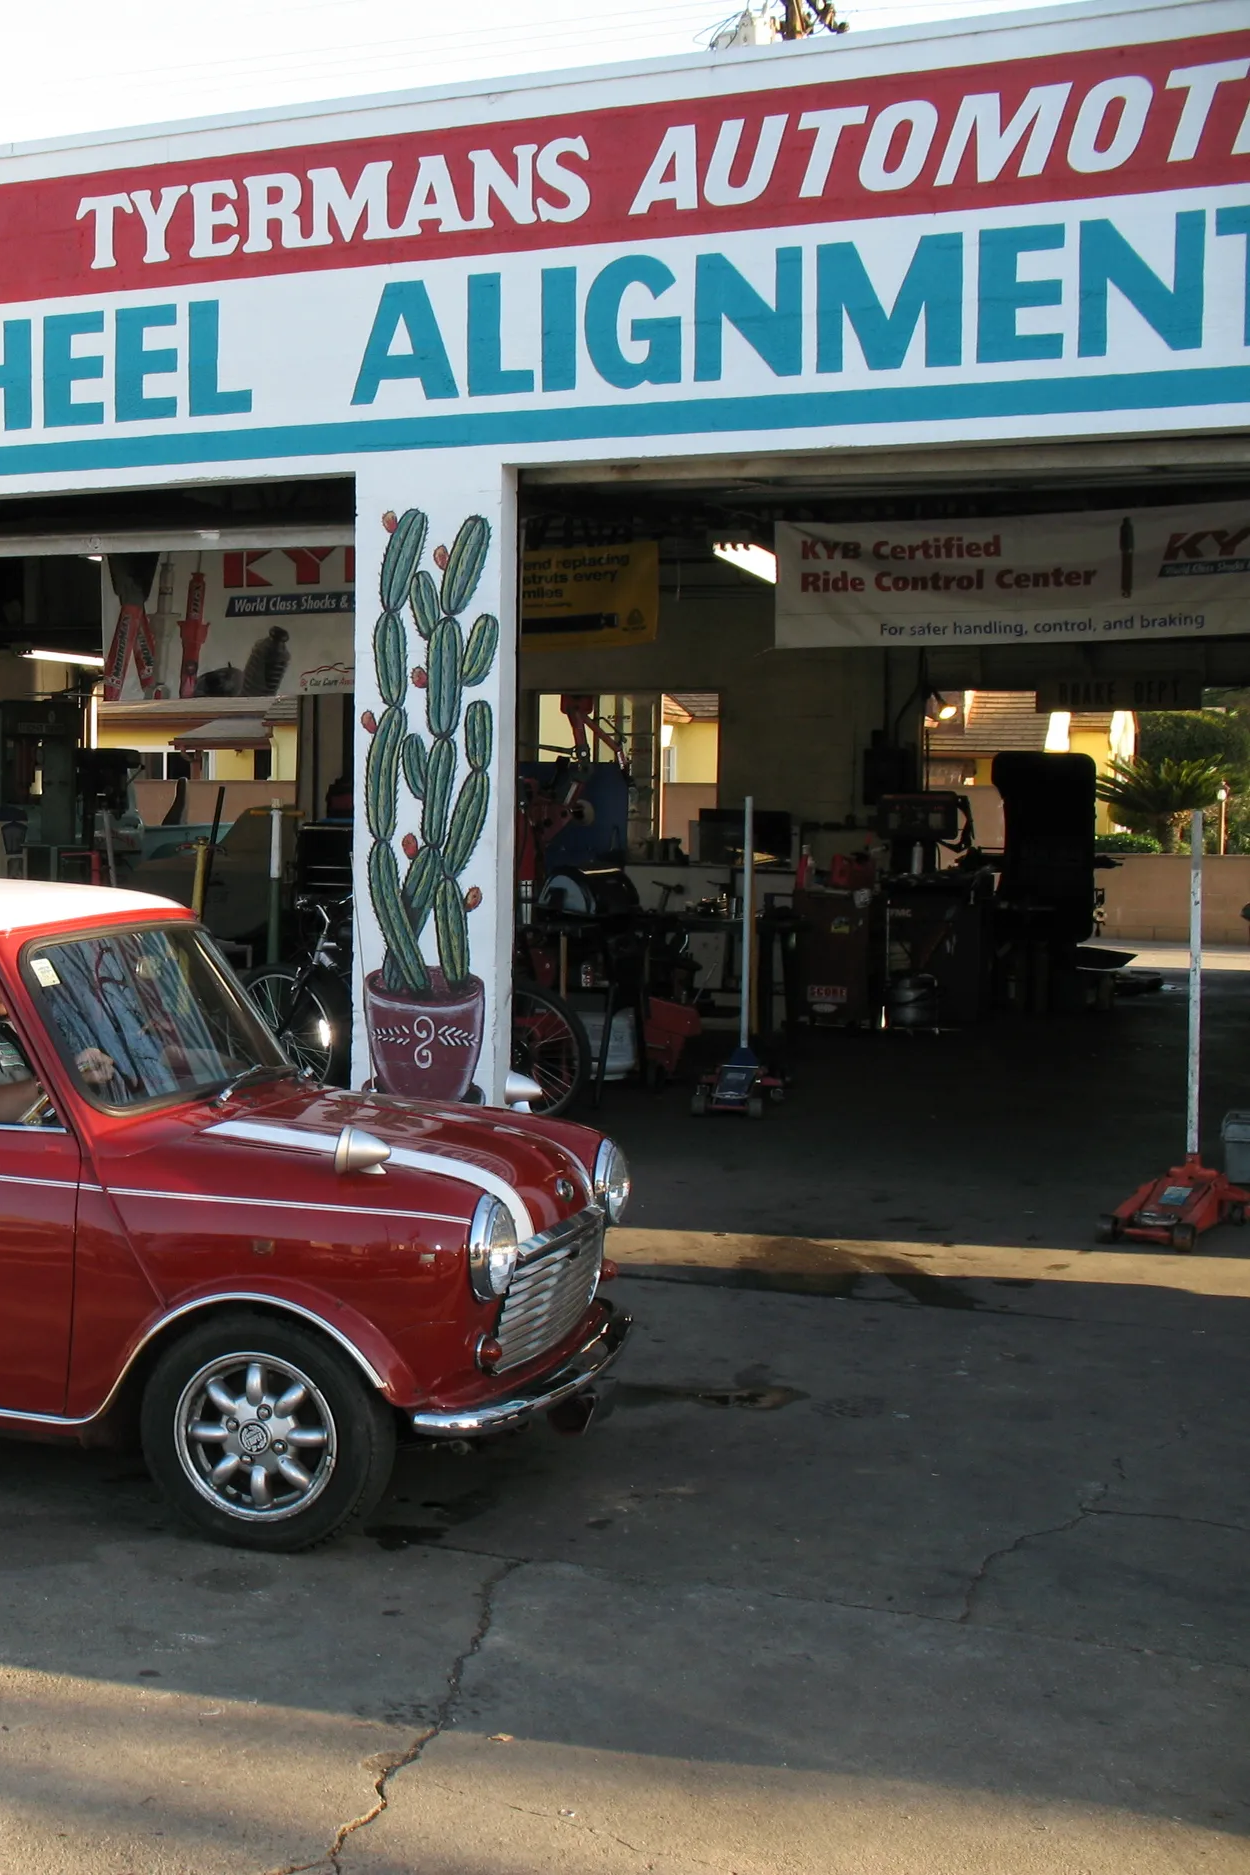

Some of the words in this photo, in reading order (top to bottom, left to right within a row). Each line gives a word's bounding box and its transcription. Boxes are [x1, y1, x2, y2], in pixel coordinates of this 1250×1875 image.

[76, 135, 591, 270] TYERMANS
[628, 57, 1250, 215] AUTOMOT
[800, 540, 862, 560] KYB
[872, 534, 1002, 560] Certified
[556, 553, 630, 570] replacing
[573, 569, 618, 584] every
[801, 571, 866, 593] Ride
[874, 568, 985, 592] Control
[995, 567, 1097, 590] Center
[234, 597, 266, 613] World
[270, 596, 297, 611] Class
[300, 594, 336, 610] Shocks
[339, 594, 349, 608] &
[880, 623, 905, 636] For
[910, 622, 948, 636] safer
[953, 621, 1028, 638] handling,
[1034, 618, 1097, 634] control,
[1103, 614, 1134, 630] and
[1140, 612, 1205, 631] braking
[1058, 681, 1116, 706] BRAKE
